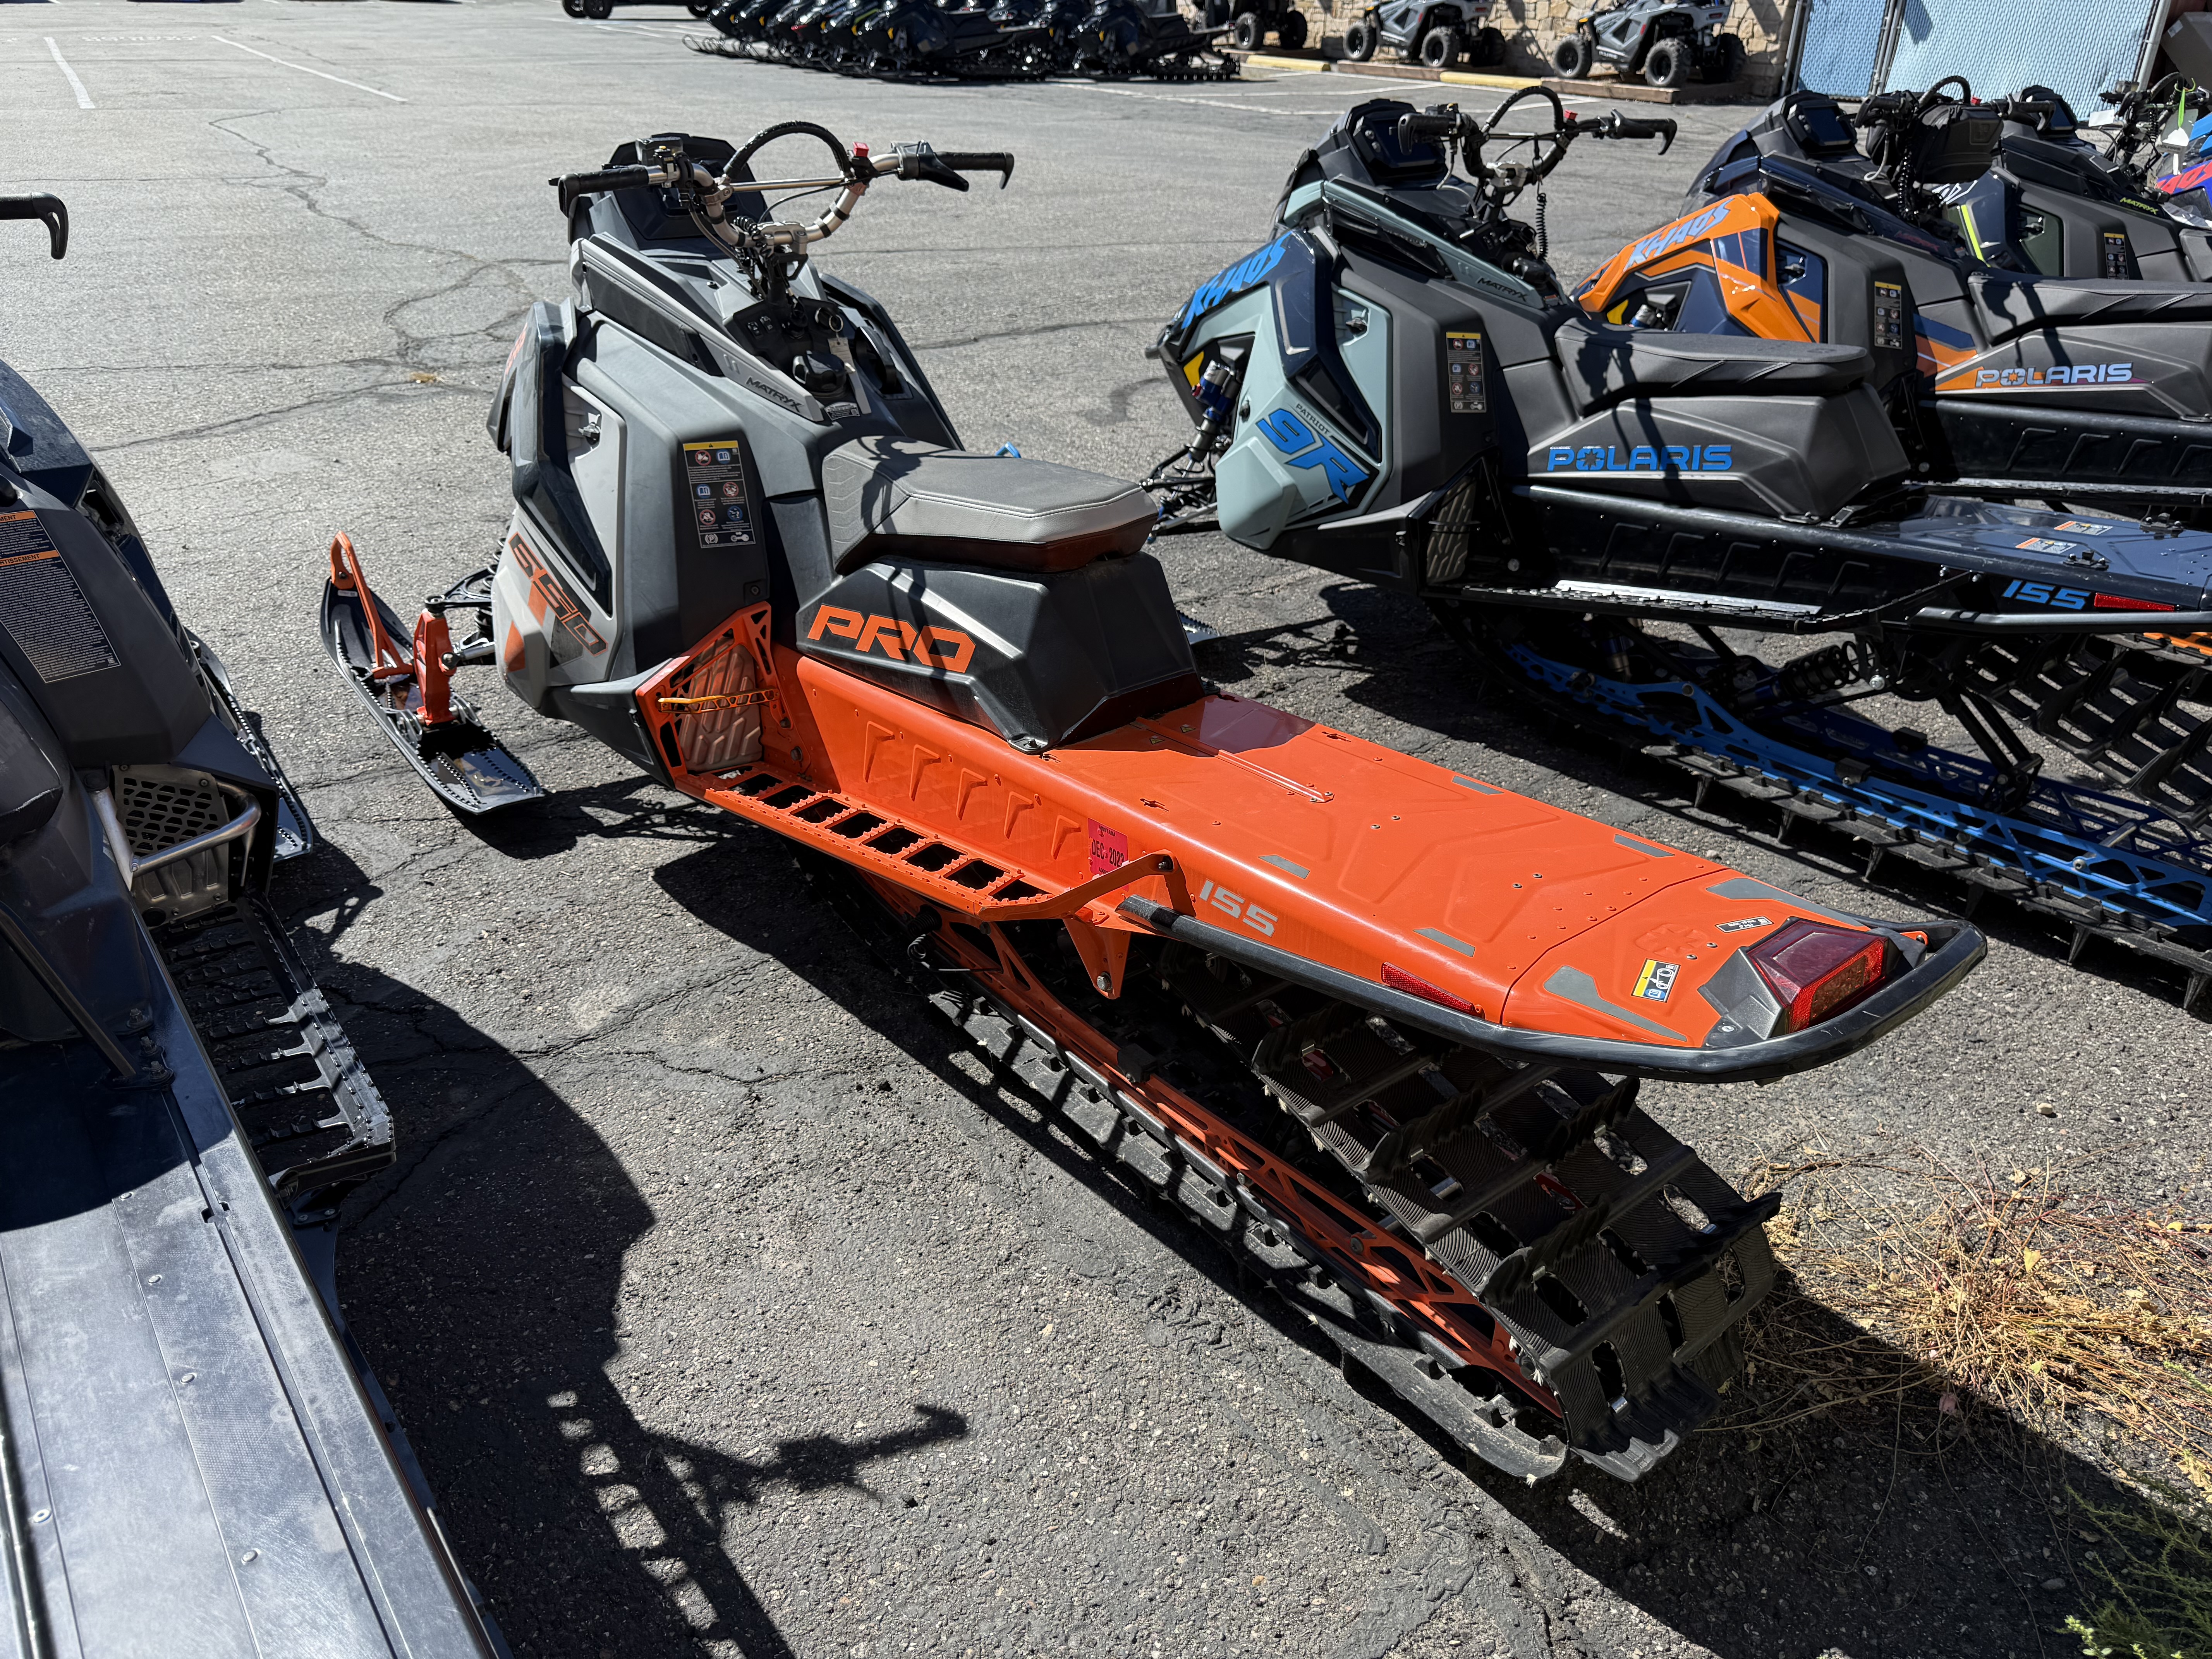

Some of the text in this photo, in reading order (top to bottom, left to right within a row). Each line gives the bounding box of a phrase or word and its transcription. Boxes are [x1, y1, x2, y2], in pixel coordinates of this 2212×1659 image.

[2119, 197, 2159, 215] MATRYX
[1623, 198, 1735, 272] KHAOS
[1181, 231, 1292, 329] KHAOS
[1476, 276, 1528, 302] MATRYX
[1975, 362, 2133, 388] POLARIS
[745, 376, 804, 413] MATRYX
[1295, 403, 1331, 435] PATRIOT
[1255, 408, 1370, 504] 9R
[1547, 445, 1733, 471] POLARIS
[2002, 580, 2090, 611] 155
[807, 604, 976, 673] PRO
[1092, 838, 1104, 860] DEC
[1199, 879, 1278, 938] 155
